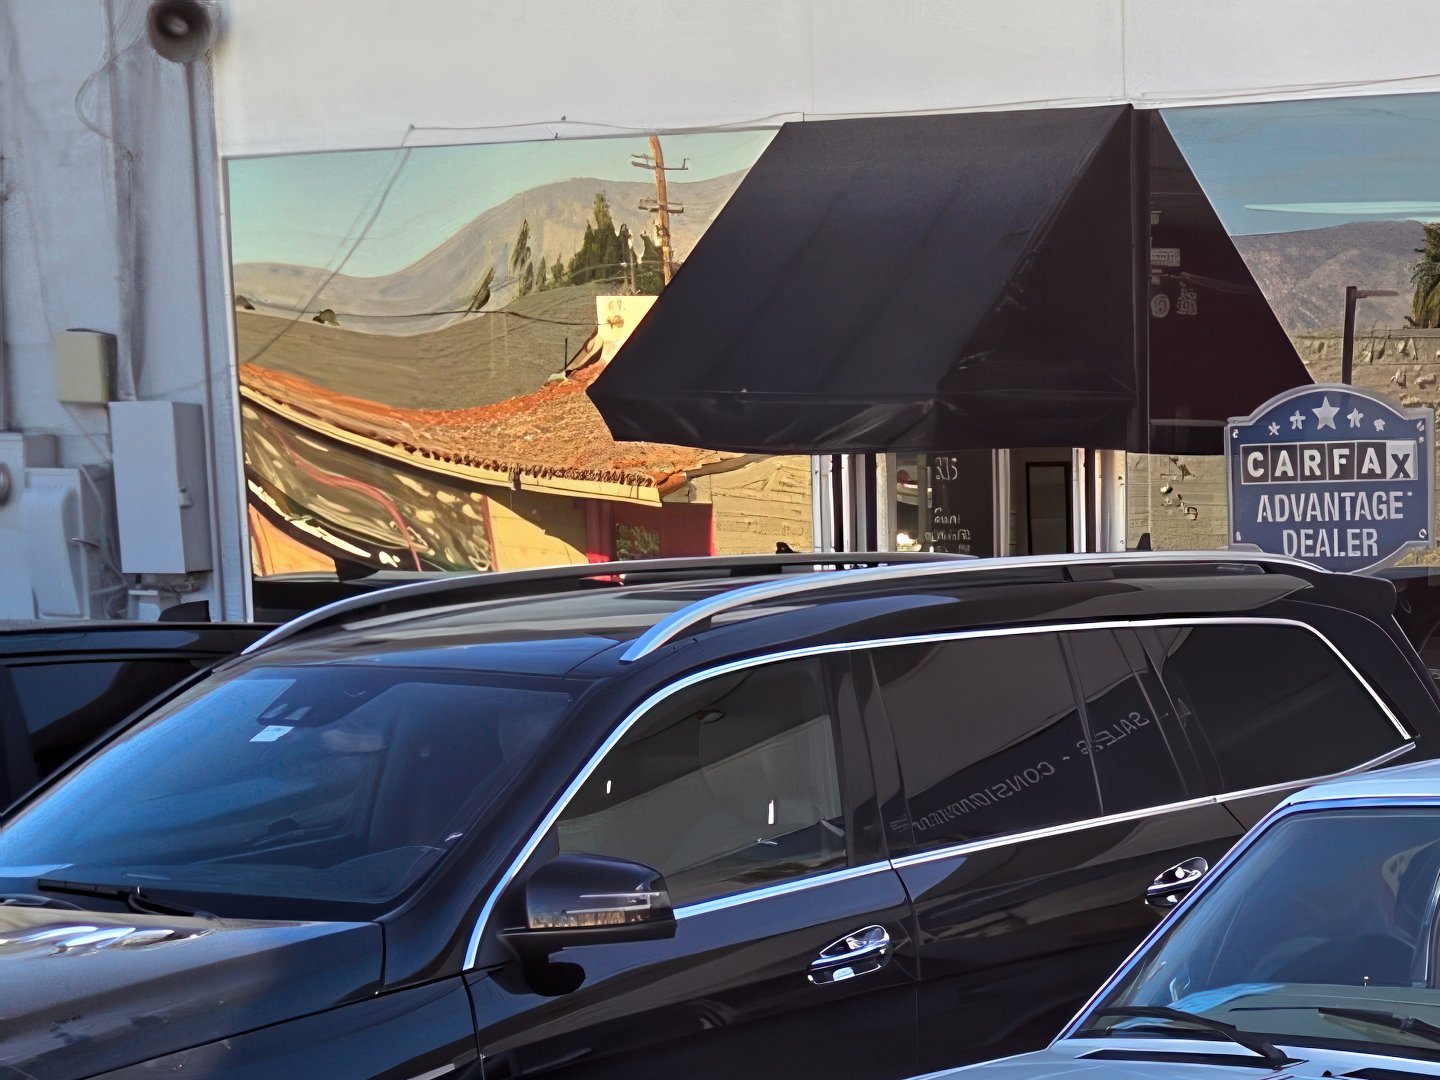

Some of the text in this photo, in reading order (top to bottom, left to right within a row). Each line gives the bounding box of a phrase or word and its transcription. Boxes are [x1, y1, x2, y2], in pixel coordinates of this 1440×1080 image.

[1246, 447, 1412, 479] CARFAX
[1256, 490, 1404, 523] ADVANTAGE
[1282, 527, 1379, 557] DEALER
